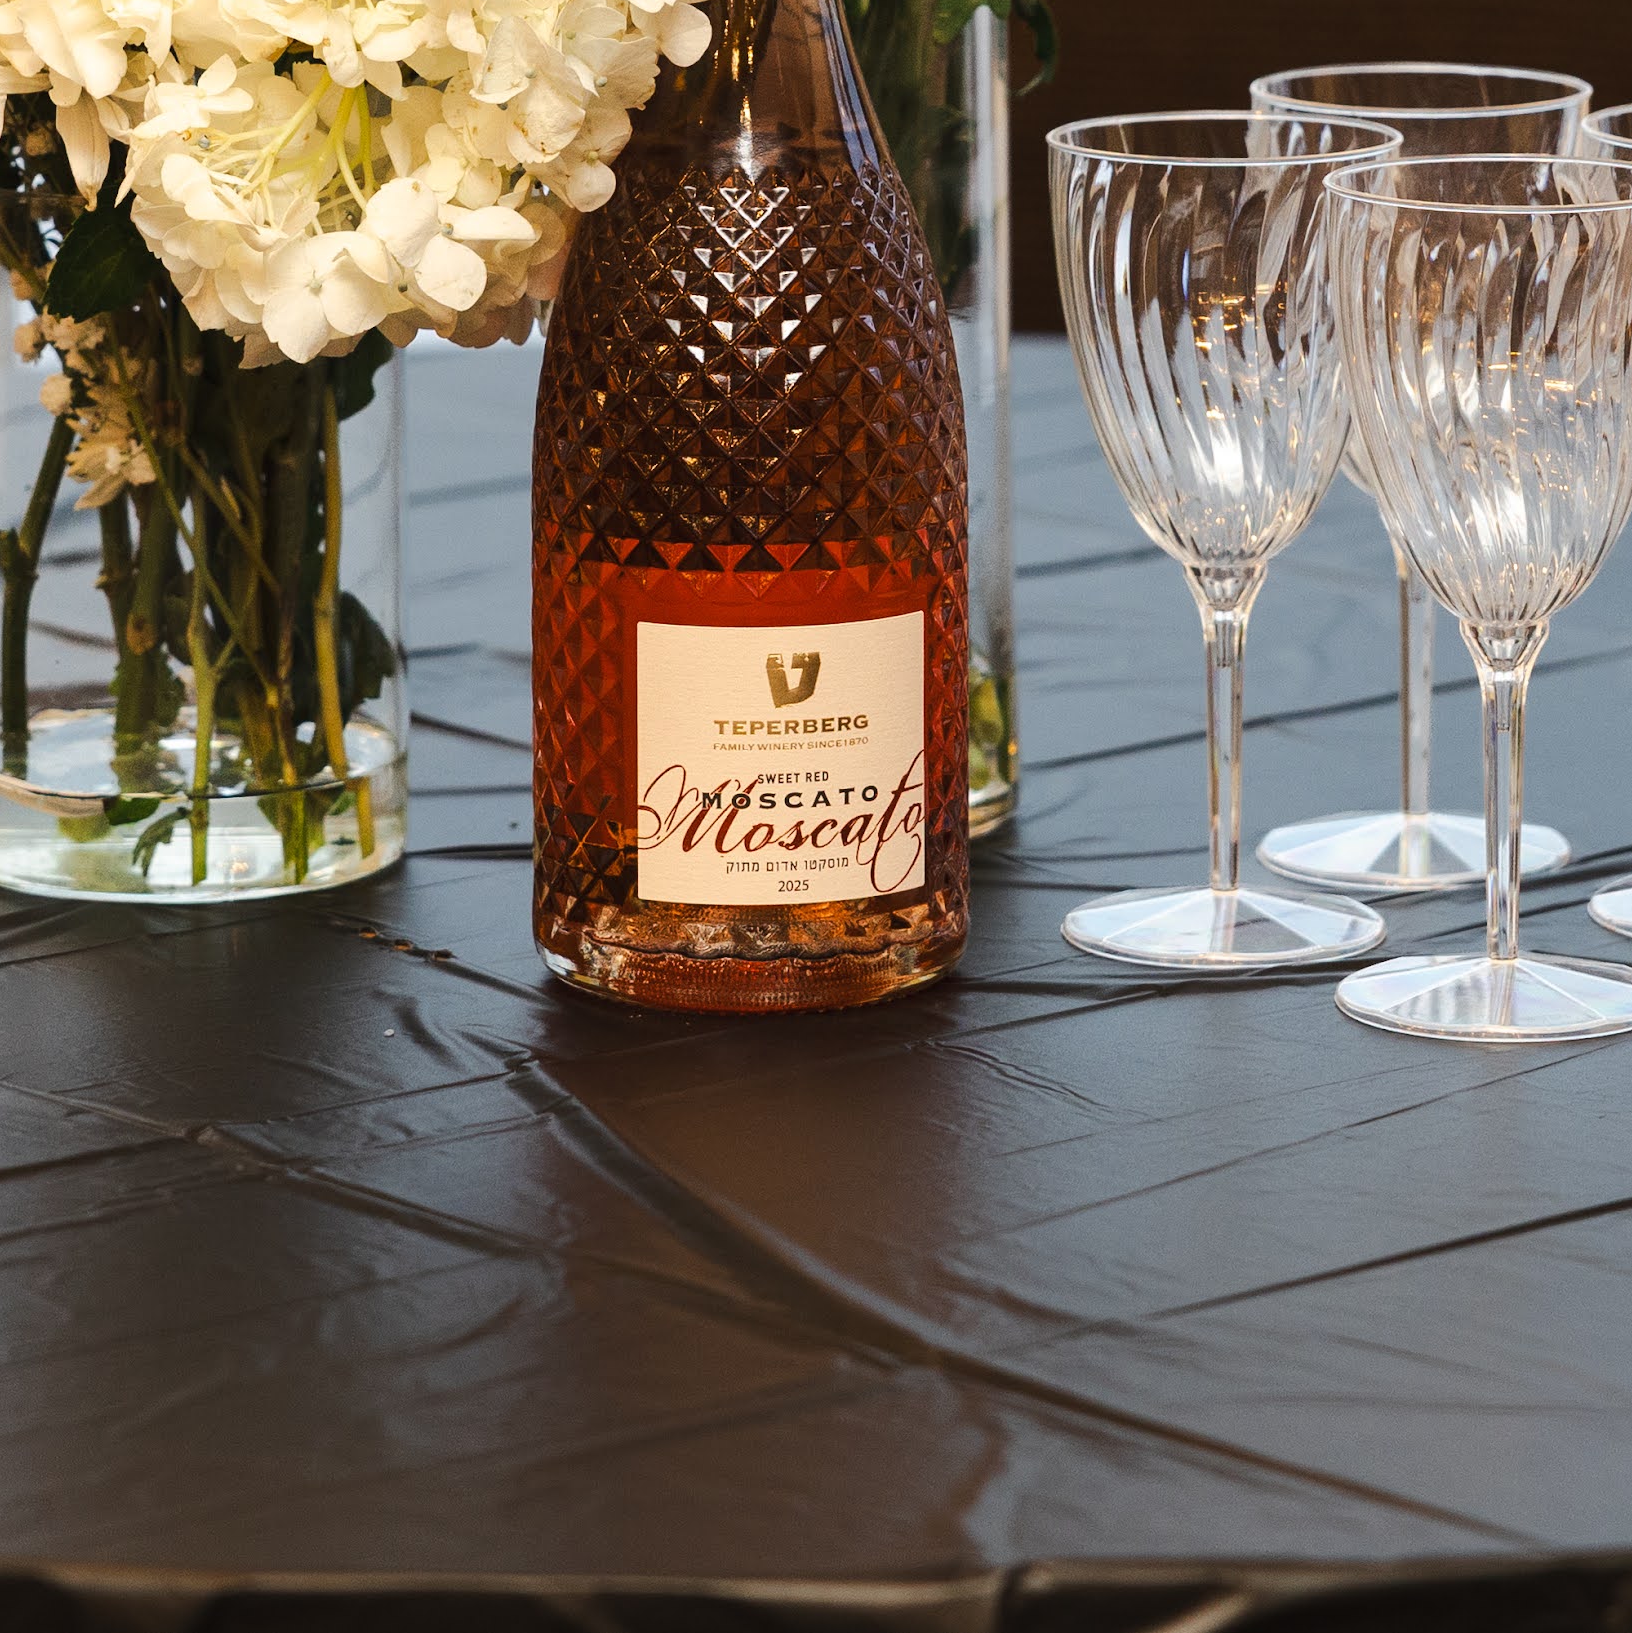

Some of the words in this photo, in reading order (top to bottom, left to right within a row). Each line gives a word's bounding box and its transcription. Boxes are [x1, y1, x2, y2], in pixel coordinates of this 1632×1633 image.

[713, 714, 869, 735] TEPERBERG
[713, 742, 755, 751] FAMILY
[756, 742, 805, 751] WINERY
[757, 772, 801, 784] SWEET
[805, 770, 829, 783] RED
[701, 785, 878, 810] MOSCATO
[638, 750, 925, 892] Moscato
[726, 861, 760, 874] מתוק
[766, 860, 798, 872] אדום
[804, 857, 849, 872] מוסקטו
[778, 879, 810, 892] 2025
